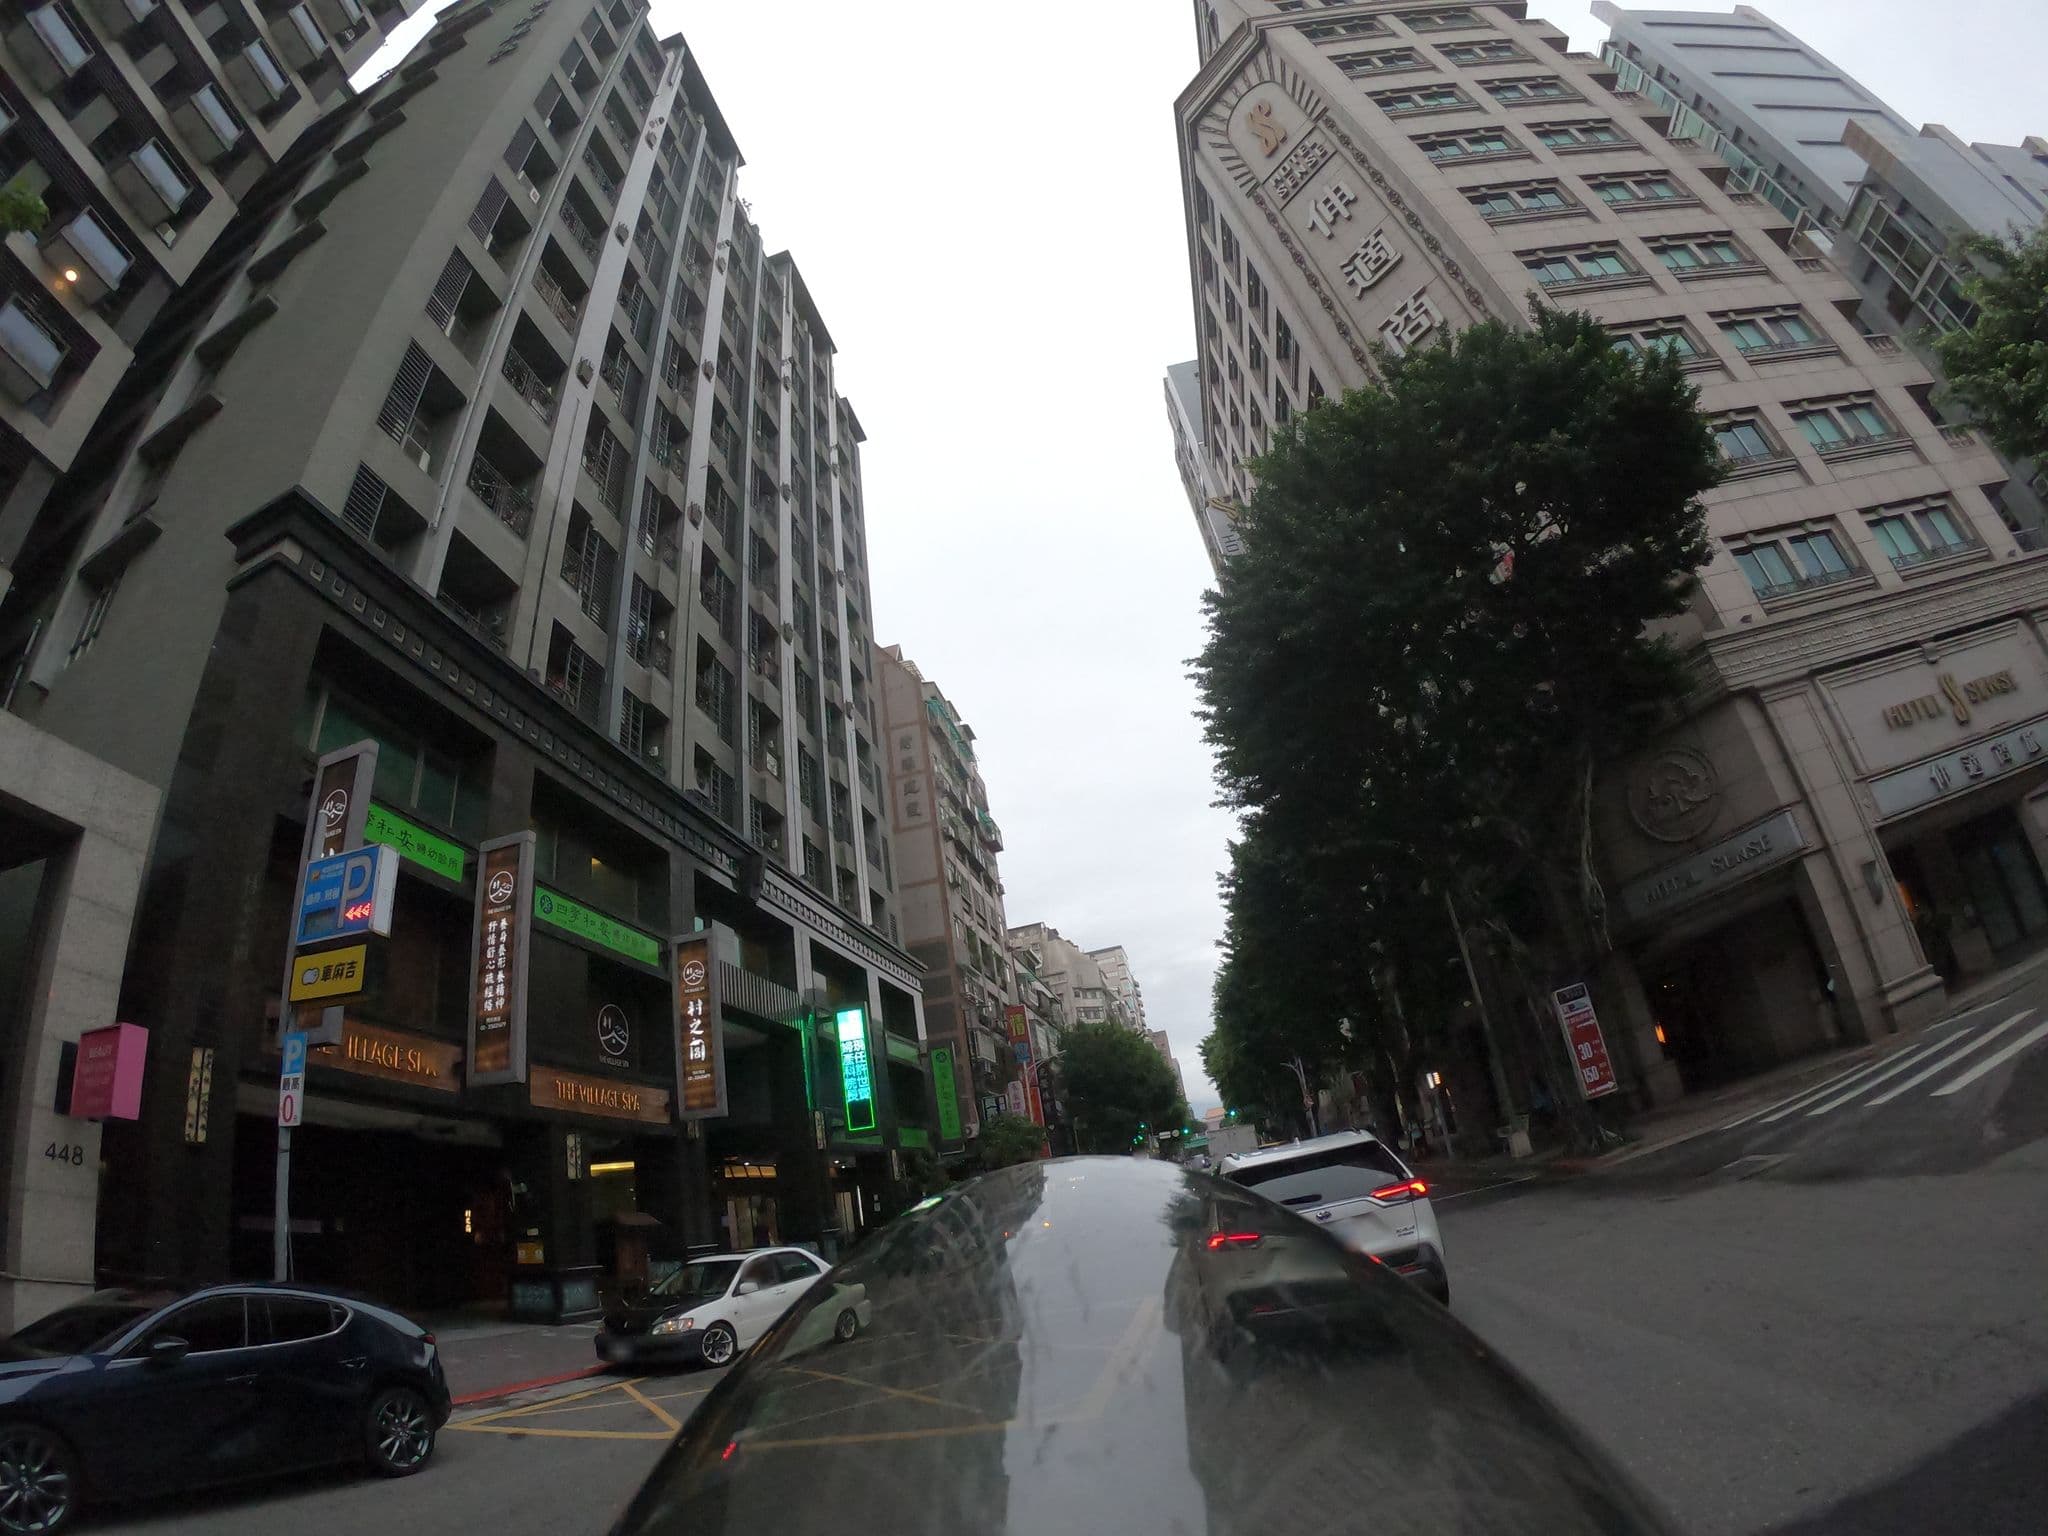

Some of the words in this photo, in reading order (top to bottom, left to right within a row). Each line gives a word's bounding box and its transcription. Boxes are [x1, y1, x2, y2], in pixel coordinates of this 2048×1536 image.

[1270, 139, 1318, 187] HOTEL
[1277, 144, 1328, 200] SENSE
[336, 855, 372, 929] P
[320, 964, 356, 983] 車麻吉
[285, 1039, 302, 1071] P
[347, 1034, 402, 1071] ILLAGE
[1577, 1042, 1593, 1061] 30
[1582, 1065, 1600, 1083] 150
[578, 1083, 619, 1109] VILLAGE
[621, 1091, 641, 1112] SPA
[44, 1142, 84, 1167] 448
